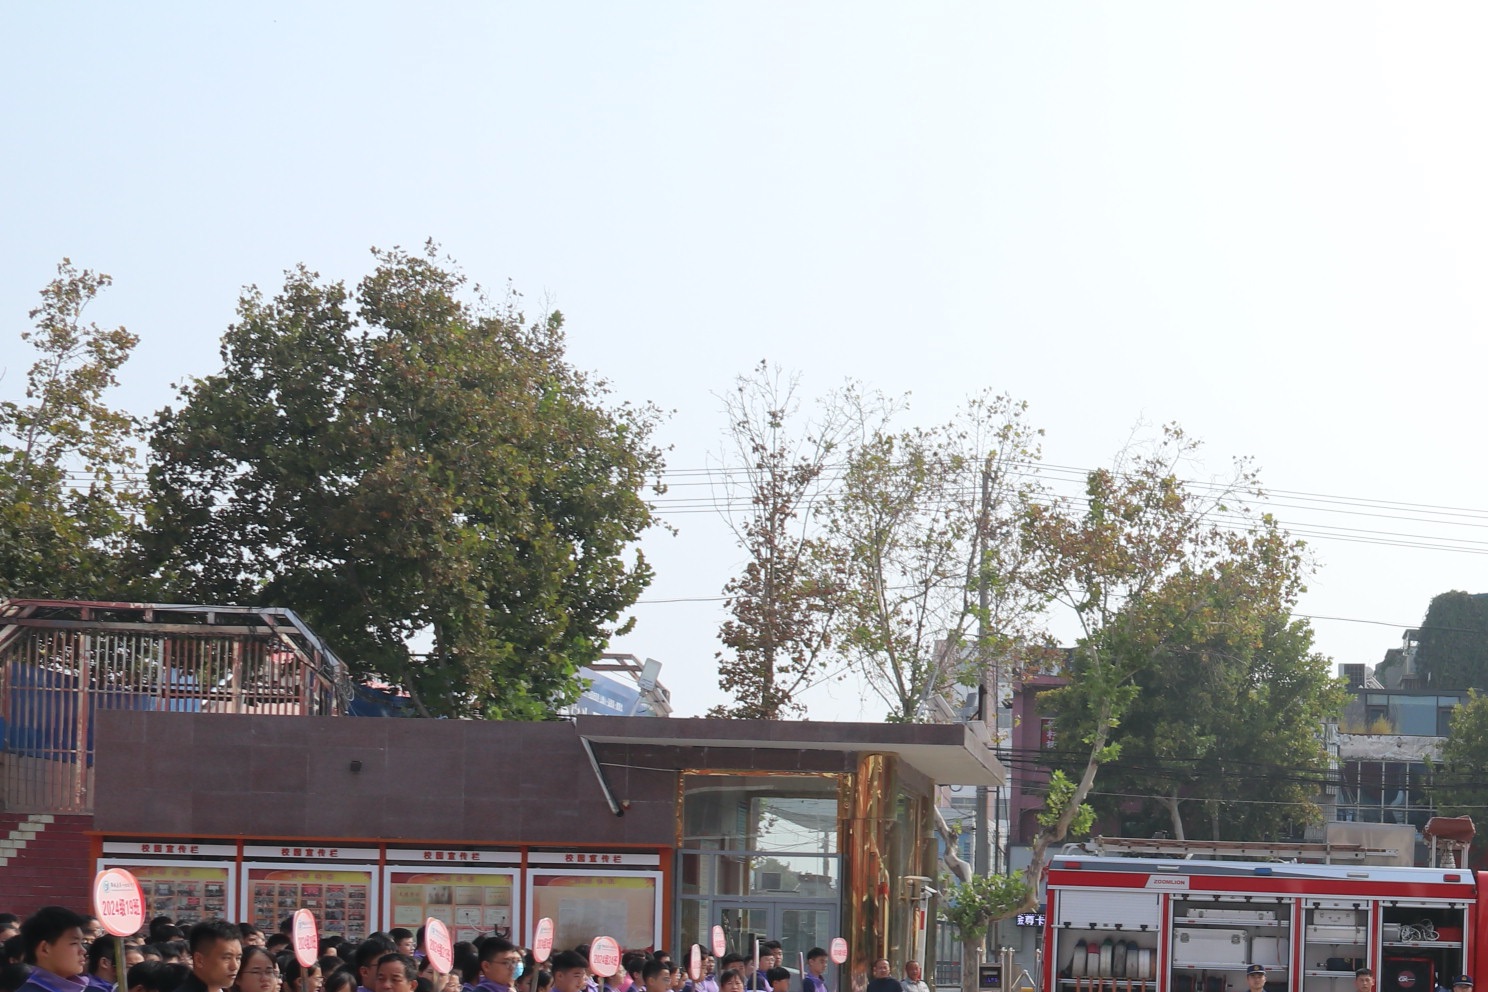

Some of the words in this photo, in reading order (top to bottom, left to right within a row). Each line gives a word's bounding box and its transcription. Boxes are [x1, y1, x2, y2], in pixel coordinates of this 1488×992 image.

[141, 844, 200, 854] 校园宣传栏
[281, 847, 339, 857] 校园宣传栏
[423, 851, 481, 861] 校园宣传栏
[565, 854, 623, 863] 校园宣传栏
[102, 898, 140, 916] 2024级19班
